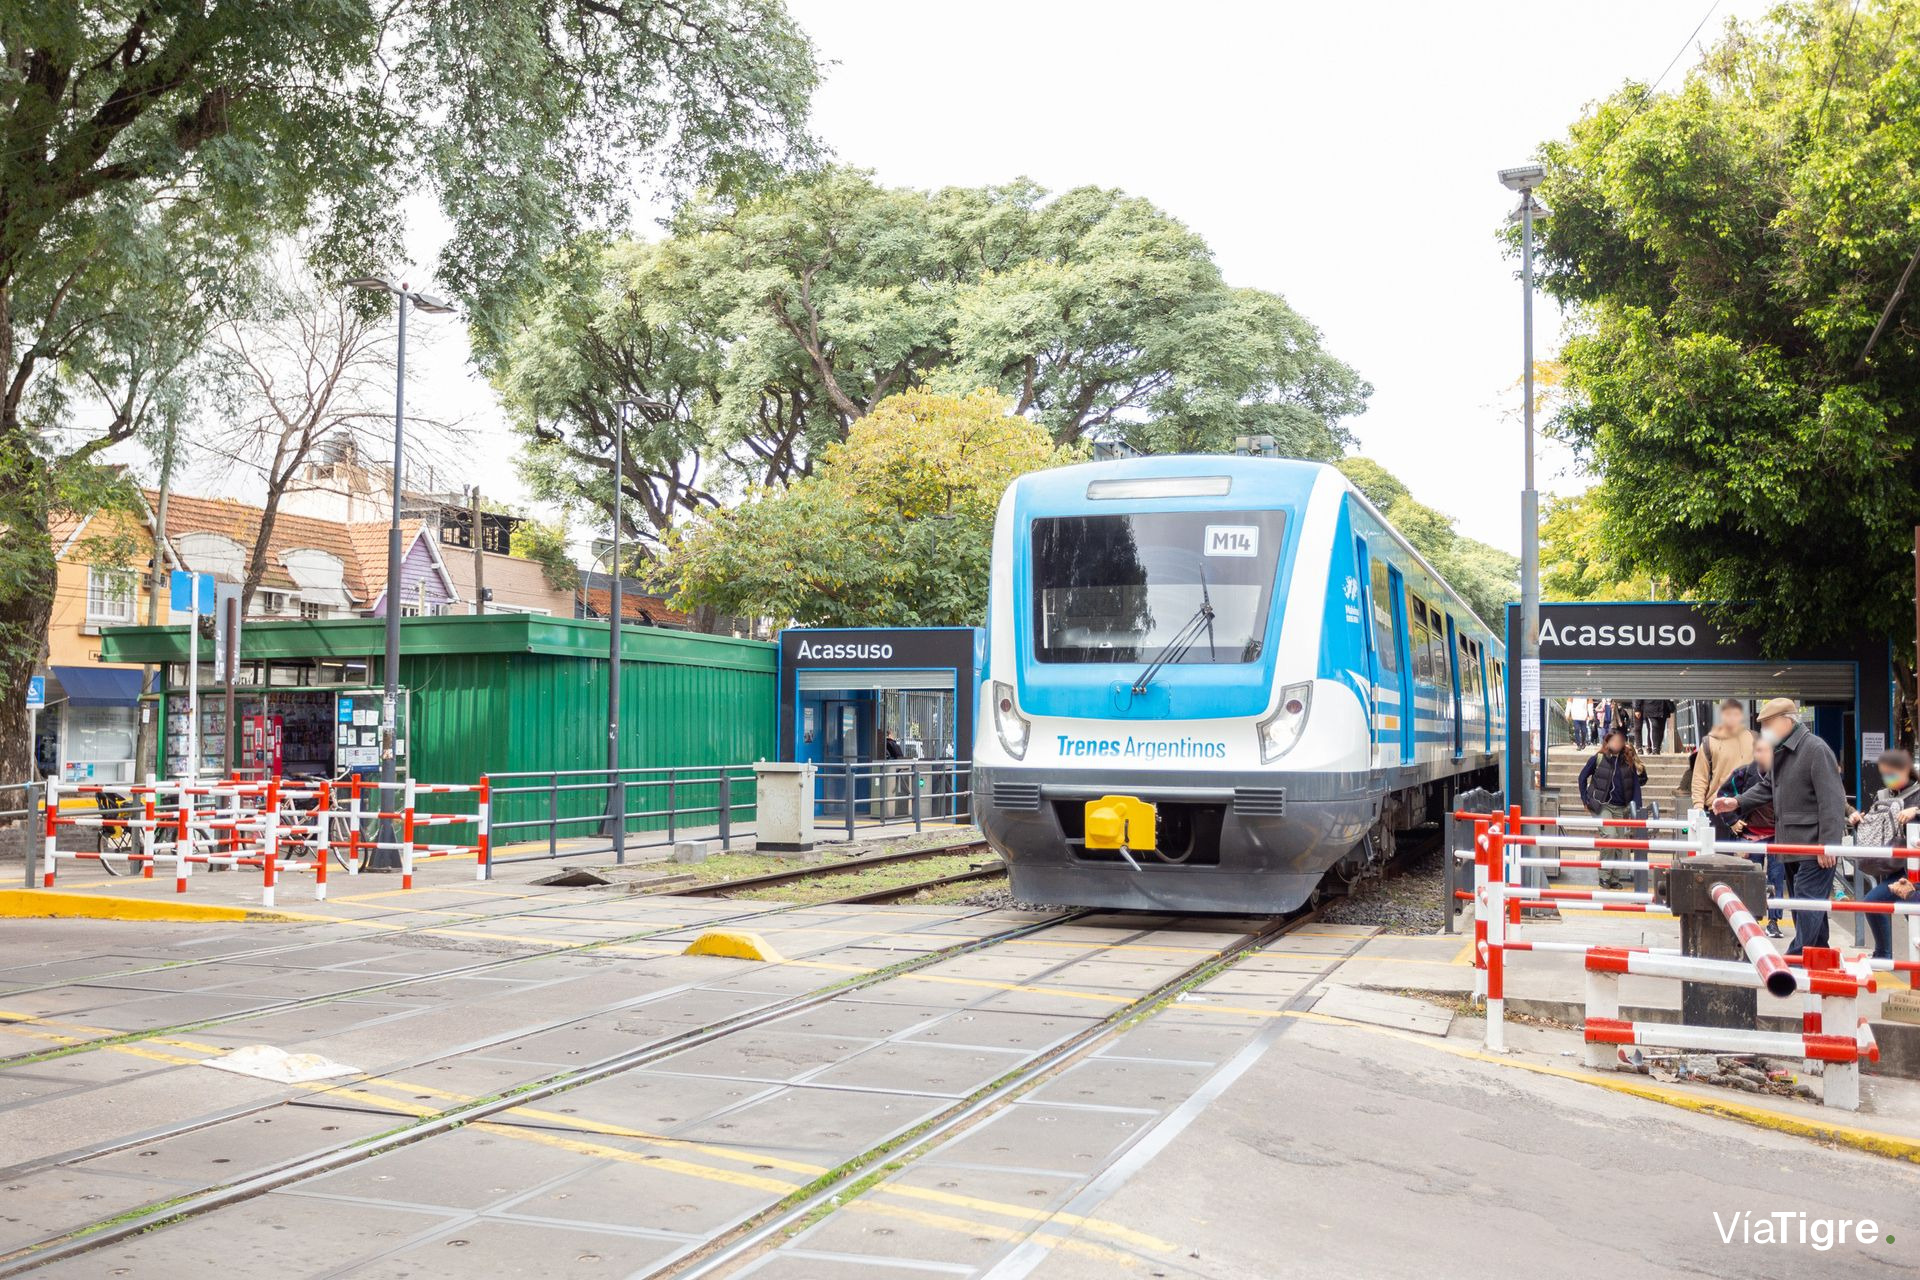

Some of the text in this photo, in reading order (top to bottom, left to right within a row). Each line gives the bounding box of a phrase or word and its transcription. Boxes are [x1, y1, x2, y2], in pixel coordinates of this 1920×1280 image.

[1212, 532, 1251, 551] M14
[1538, 618, 1697, 646] Acassuso
[797, 639, 893, 660] Acassuso
[1057, 735, 1226, 762] Trenes Argentinos
